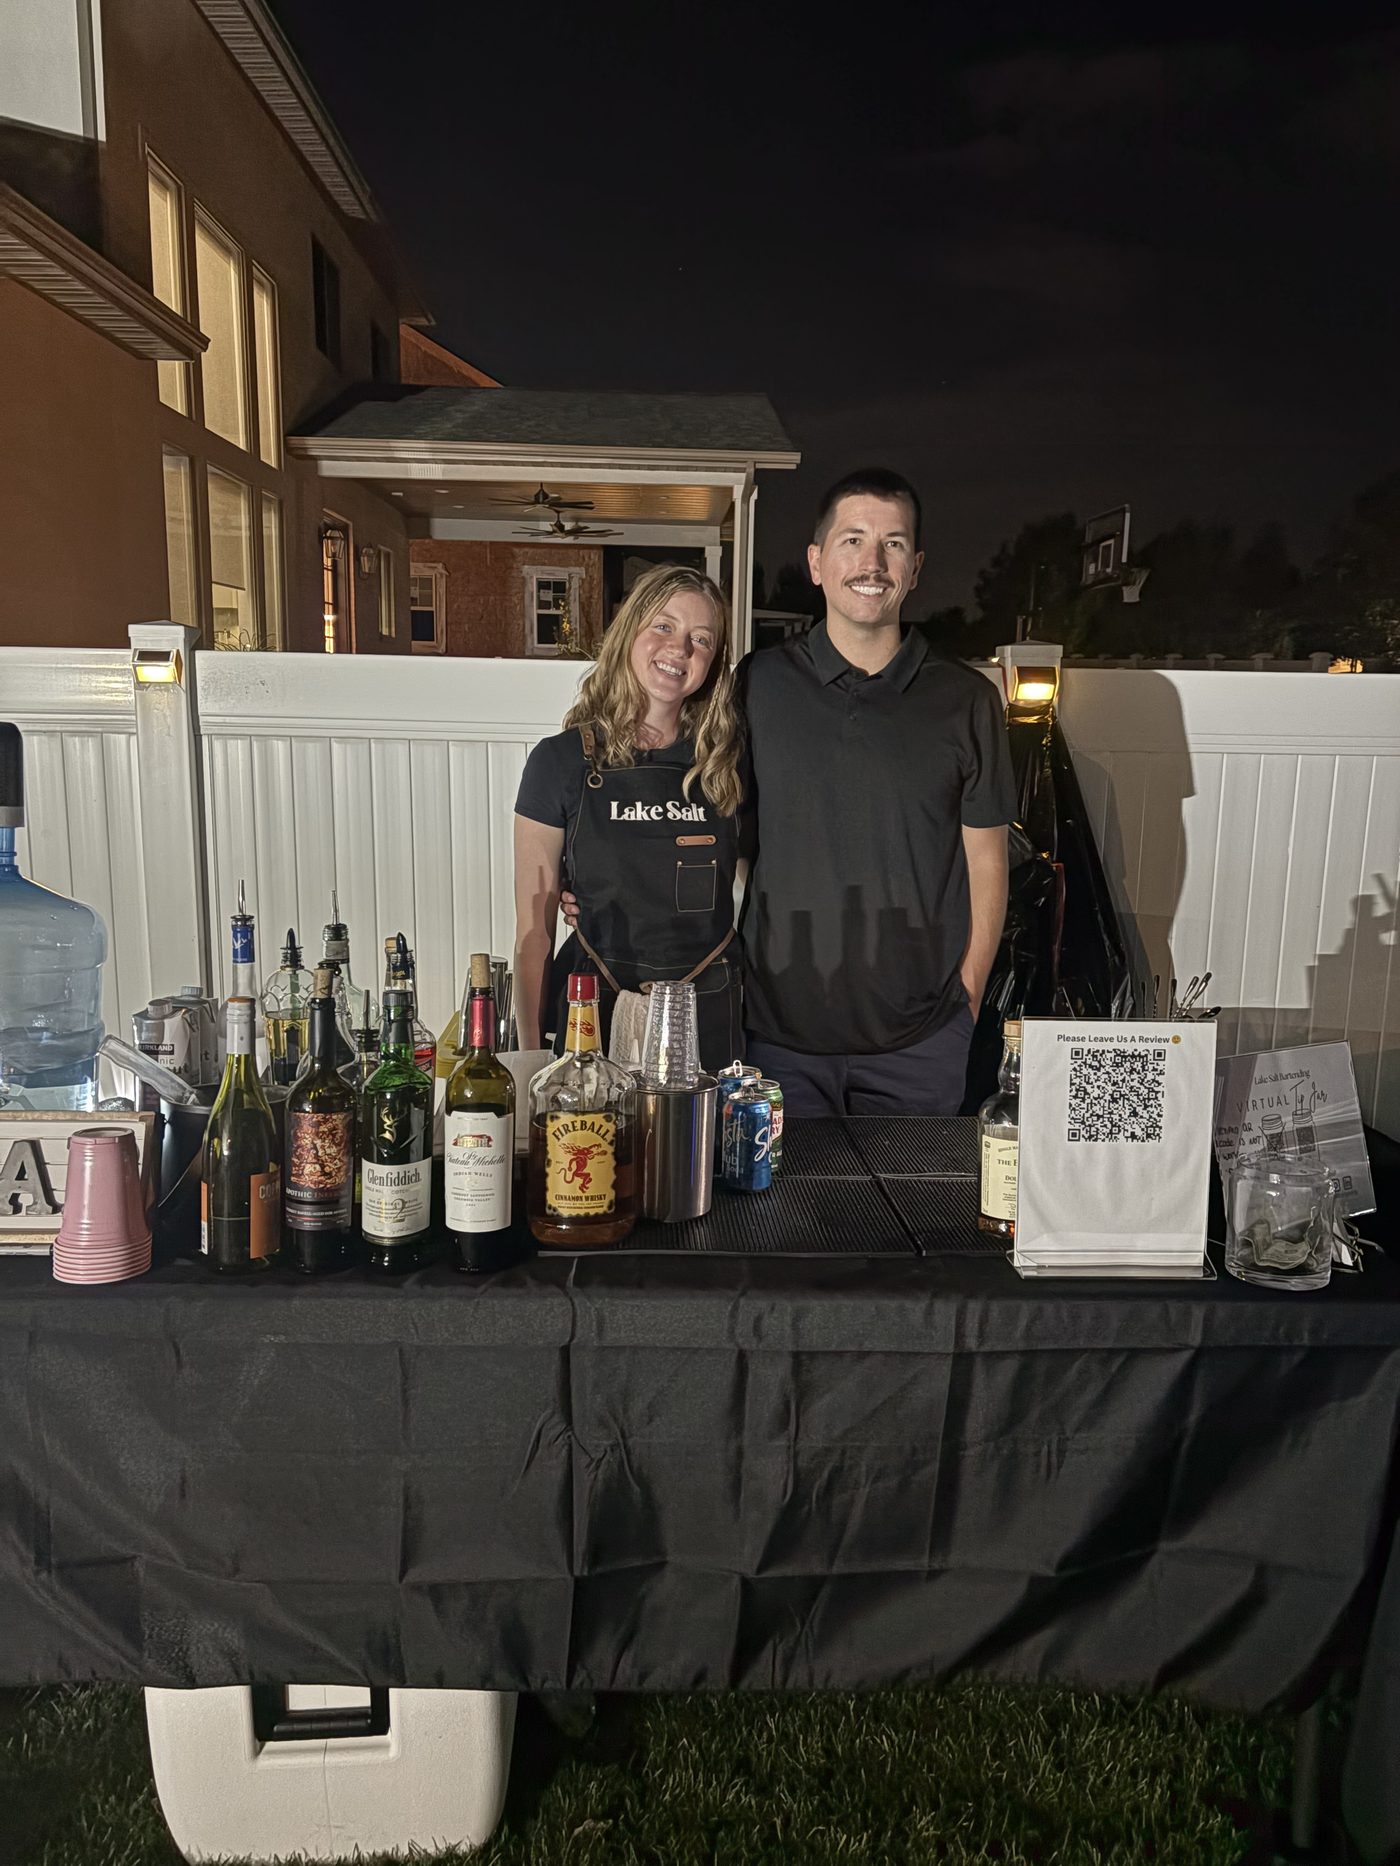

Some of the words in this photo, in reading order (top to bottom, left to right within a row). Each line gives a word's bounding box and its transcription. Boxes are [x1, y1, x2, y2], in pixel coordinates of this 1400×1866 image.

[610, 801, 663, 821] Lake
[666, 801, 707, 822] Salt
[1057, 1034, 1086, 1043] Please
[1088, 1034, 1115, 1043] Leave
[1116, 1034, 1128, 1043] Us
[1129, 1035, 1137, 1043] A
[1138, 1035, 1170, 1044] Review
[1254, 1074, 1268, 1085] Lake
[1268, 1071, 1280, 1082] Salt
[1236, 1094, 1290, 1113] VIRTUAL
[1309, 1081, 1328, 1113] Jar
[552, 1119, 610, 1141] FIREBALL
[555, 1194, 583, 1202] CINNAMON
[585, 1193, 607, 1202] WHISKY
